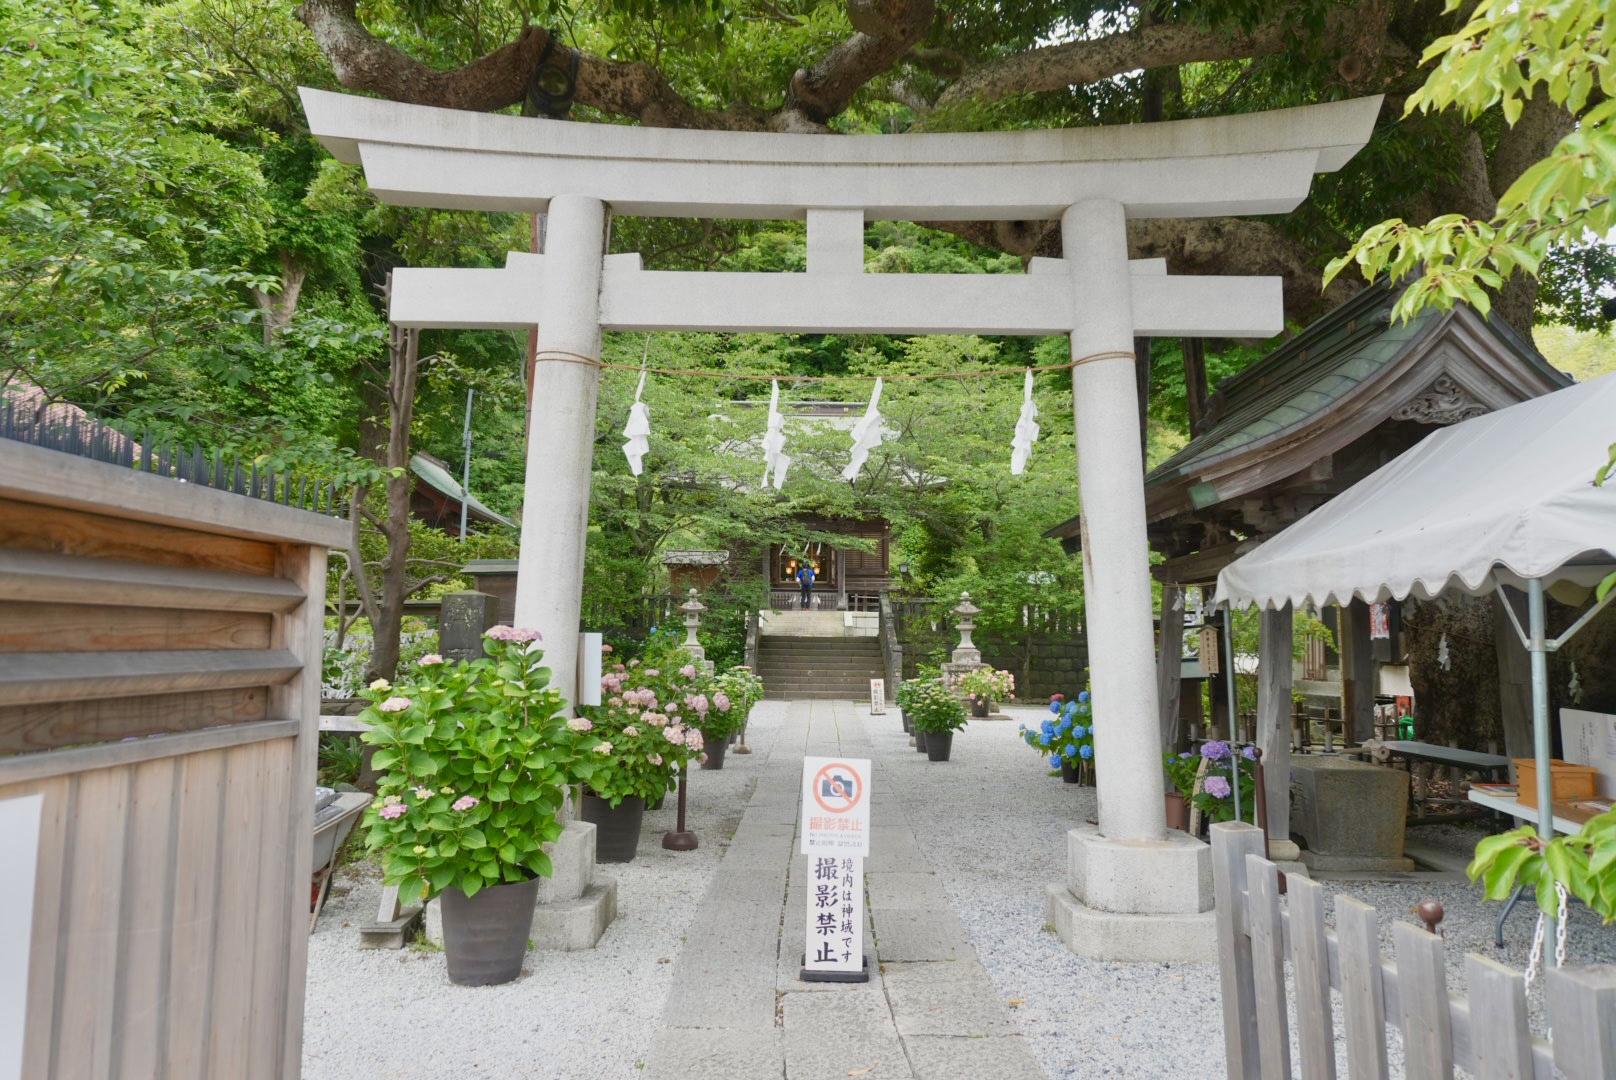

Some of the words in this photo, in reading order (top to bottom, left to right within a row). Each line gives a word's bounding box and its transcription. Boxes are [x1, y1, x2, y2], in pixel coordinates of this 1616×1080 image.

[809, 816, 863, 831] 撮影禁止
[813, 857, 839, 963] 撮影禁止
[841, 858, 853, 963] 境内は神域です
